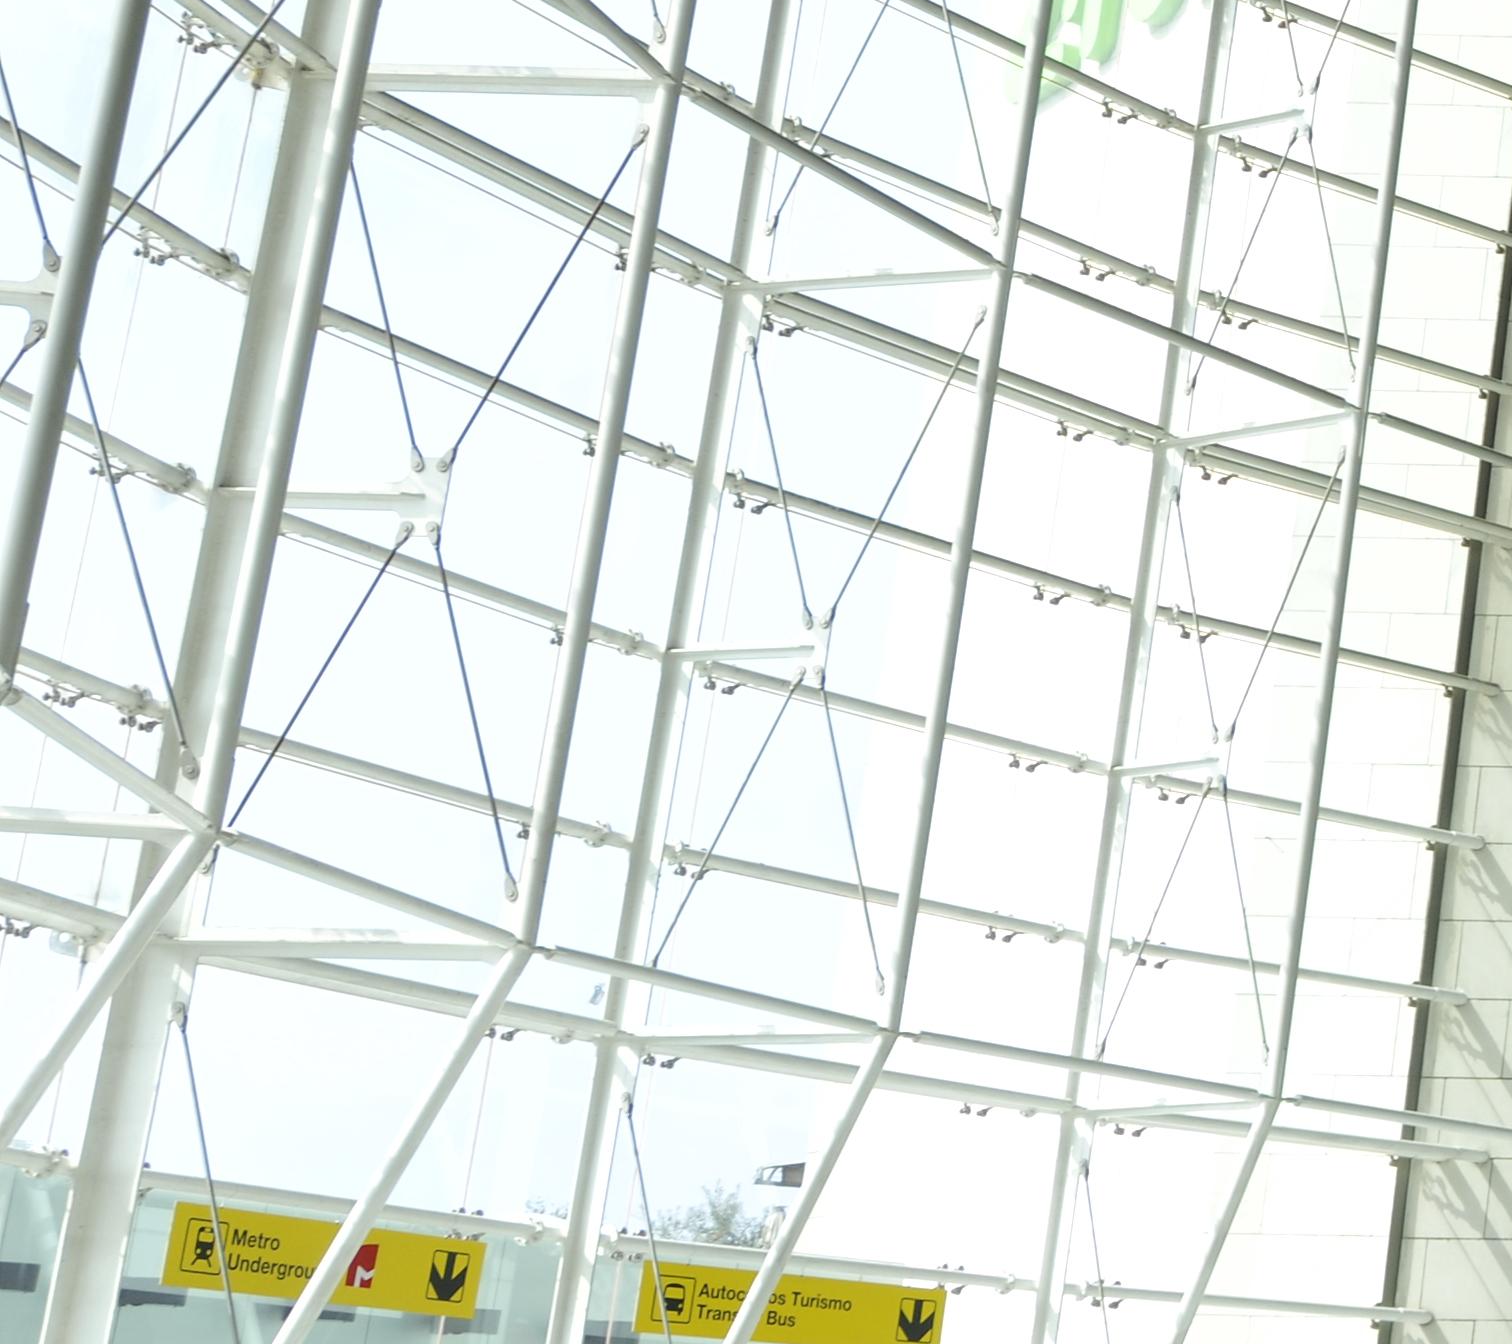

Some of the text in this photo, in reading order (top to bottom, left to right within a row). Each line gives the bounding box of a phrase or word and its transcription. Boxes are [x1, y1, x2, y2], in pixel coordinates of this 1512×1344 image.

[231, 1228, 281, 1251] Metro
[227, 1253, 317, 1280] Undergrou
[698, 1282, 852, 1312] Autocos Turismo
[697, 1304, 797, 1328] Trans Bus
